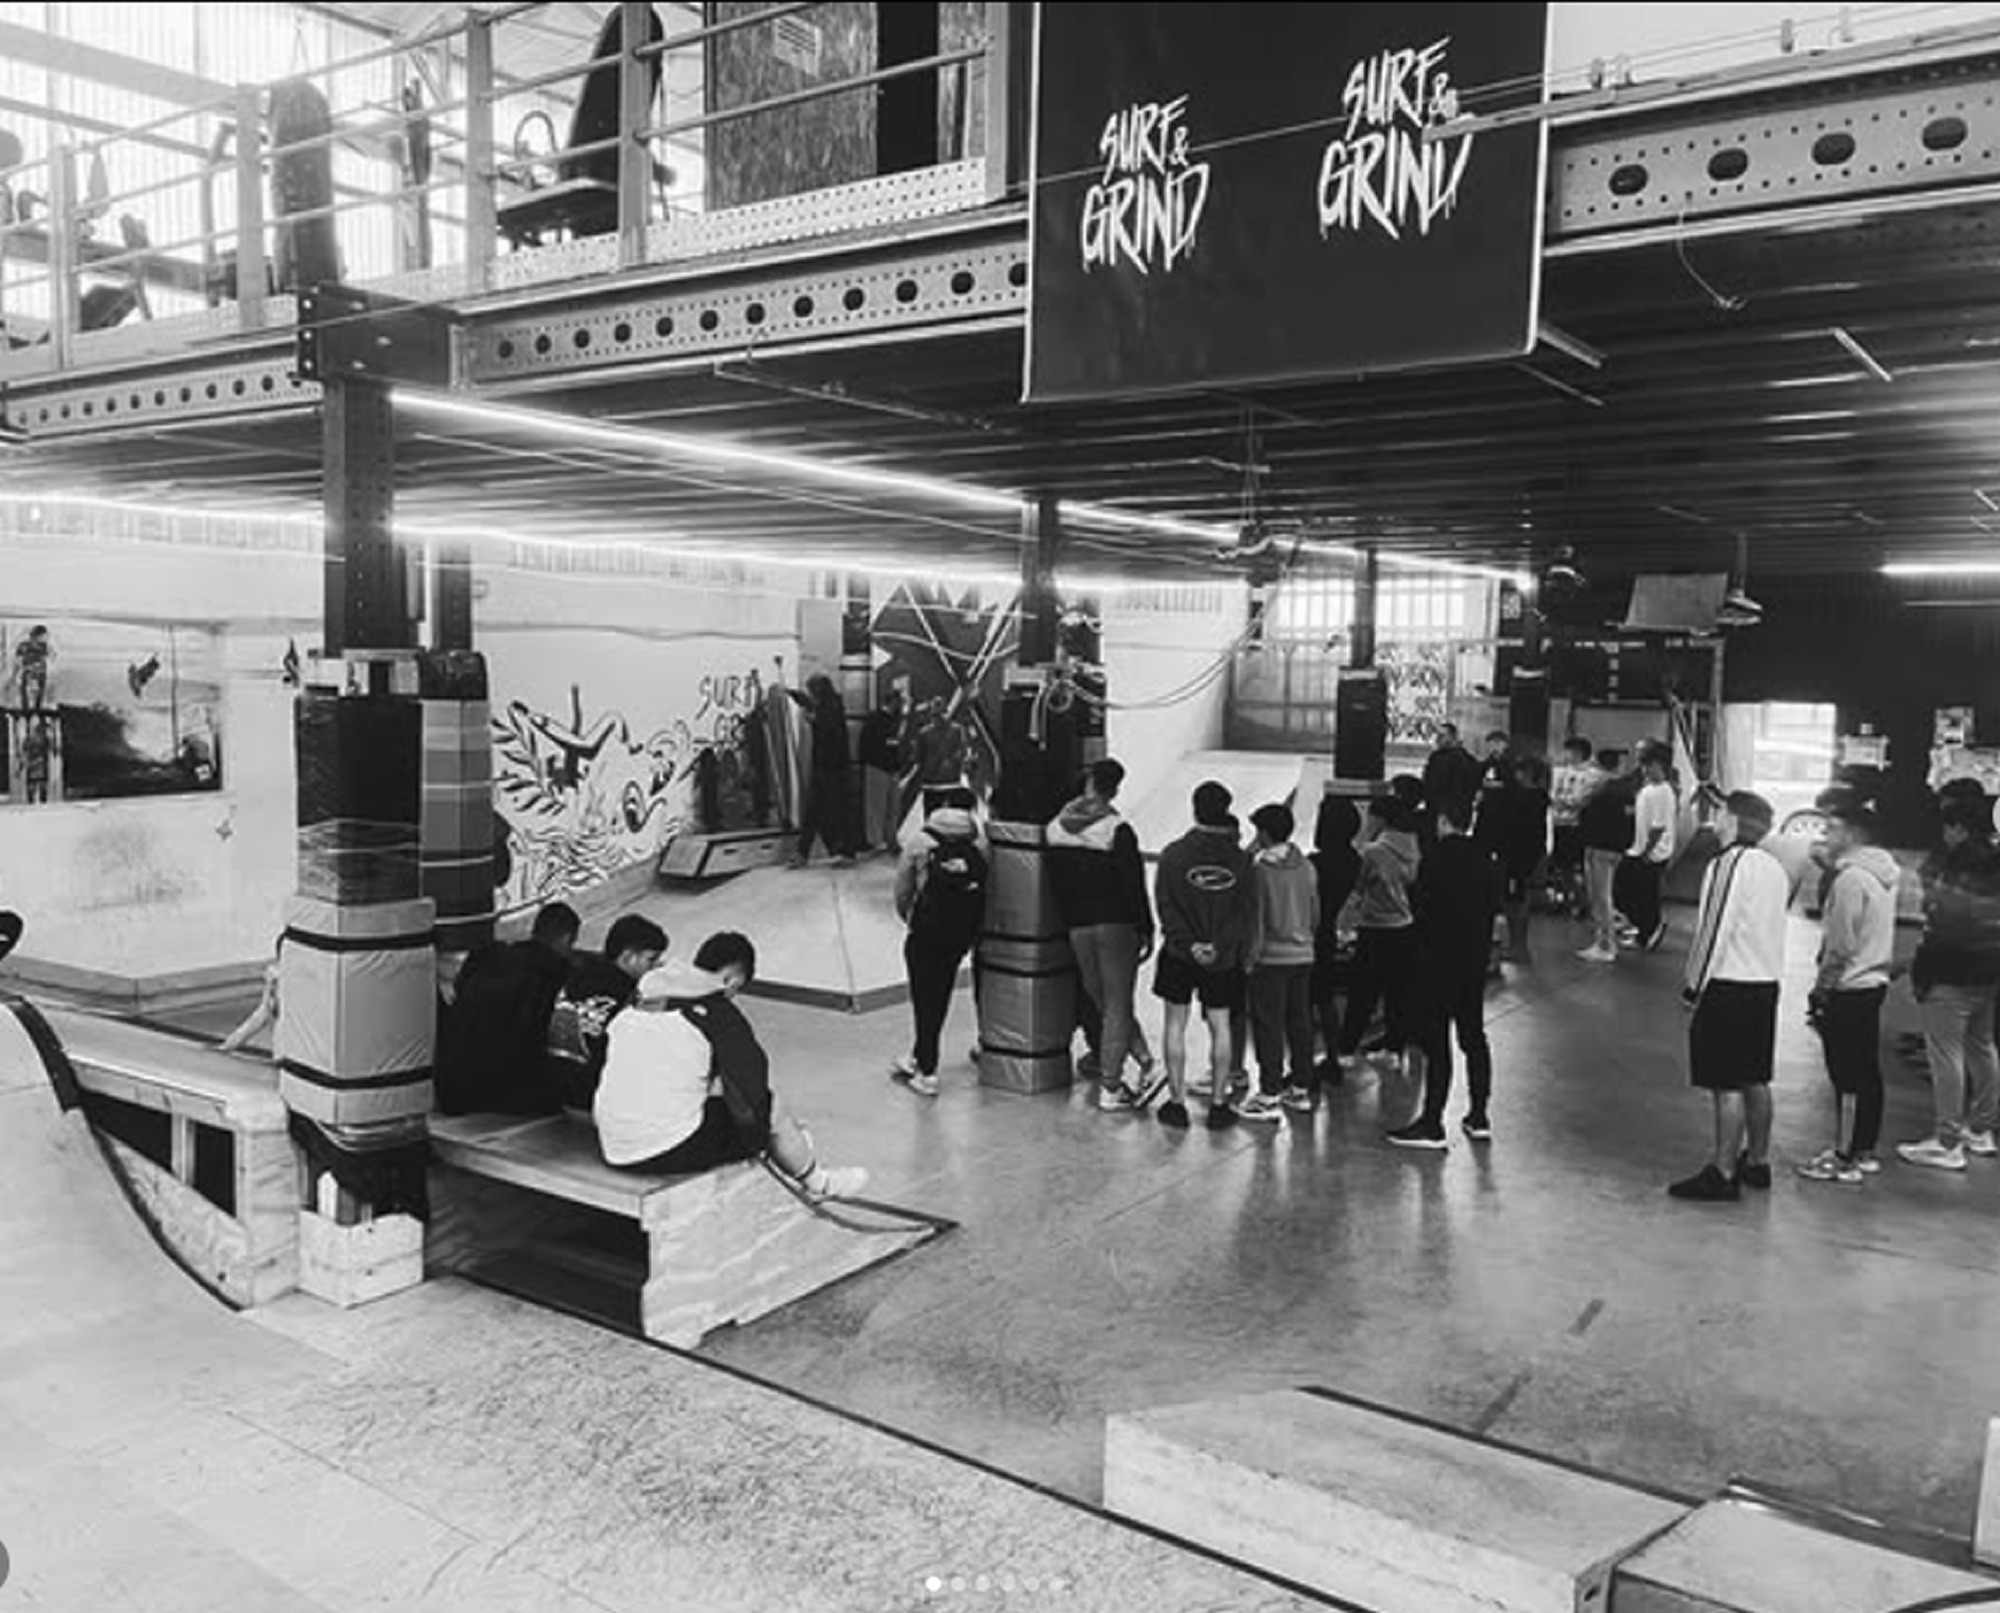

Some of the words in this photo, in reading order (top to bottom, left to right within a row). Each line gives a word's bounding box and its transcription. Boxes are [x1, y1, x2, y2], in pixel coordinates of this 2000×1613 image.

[1099, 94, 1189, 184] SURF
[1343, 36, 1451, 139] SURF
[1080, 164, 1210, 274] GRIND
[1317, 113, 1476, 239] GRIND
